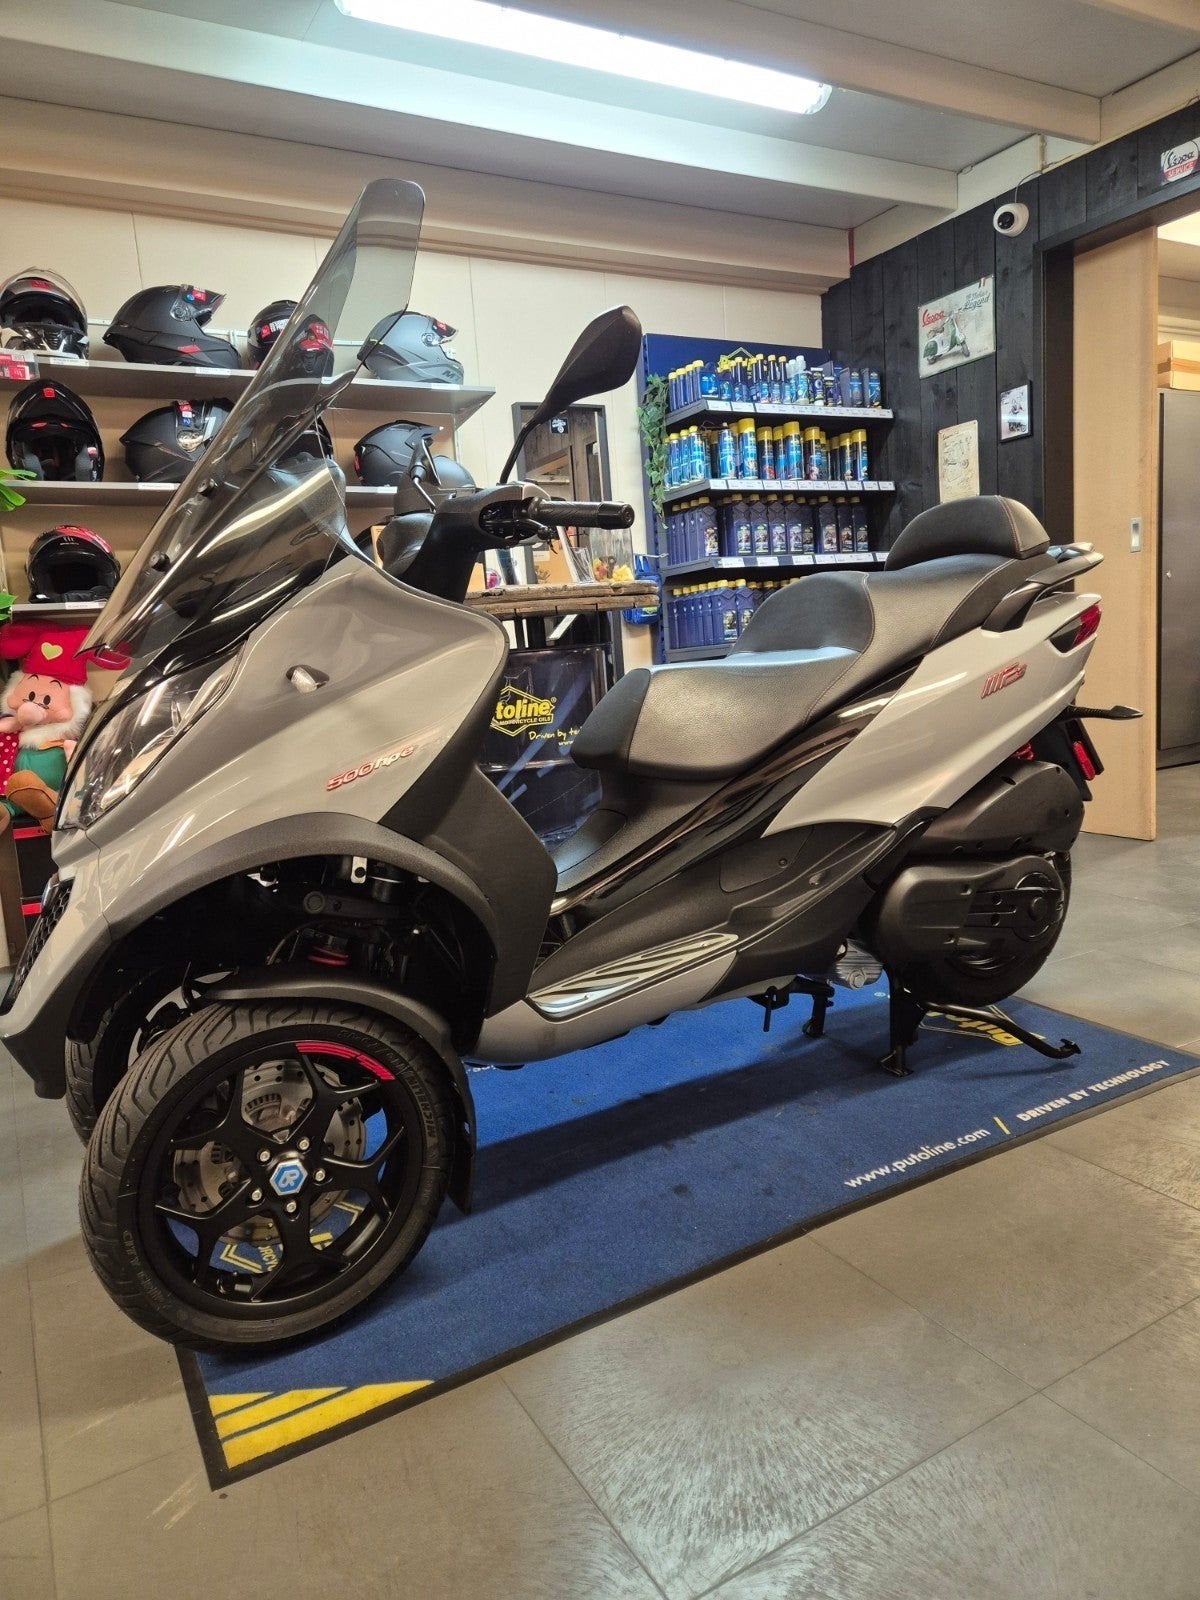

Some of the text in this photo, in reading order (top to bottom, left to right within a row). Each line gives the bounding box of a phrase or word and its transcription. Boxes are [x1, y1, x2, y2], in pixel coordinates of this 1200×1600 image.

[1167, 160, 1196, 178] SERVICE
[922, 309, 945, 328] Vespa
[528, 730, 555, 741] Driven
[557, 729, 567, 741] by
[1016, 1060, 1170, 1122] DRIVEN BY TECHNOLOGY
[844, 1128, 992, 1188] www.putoline.com
